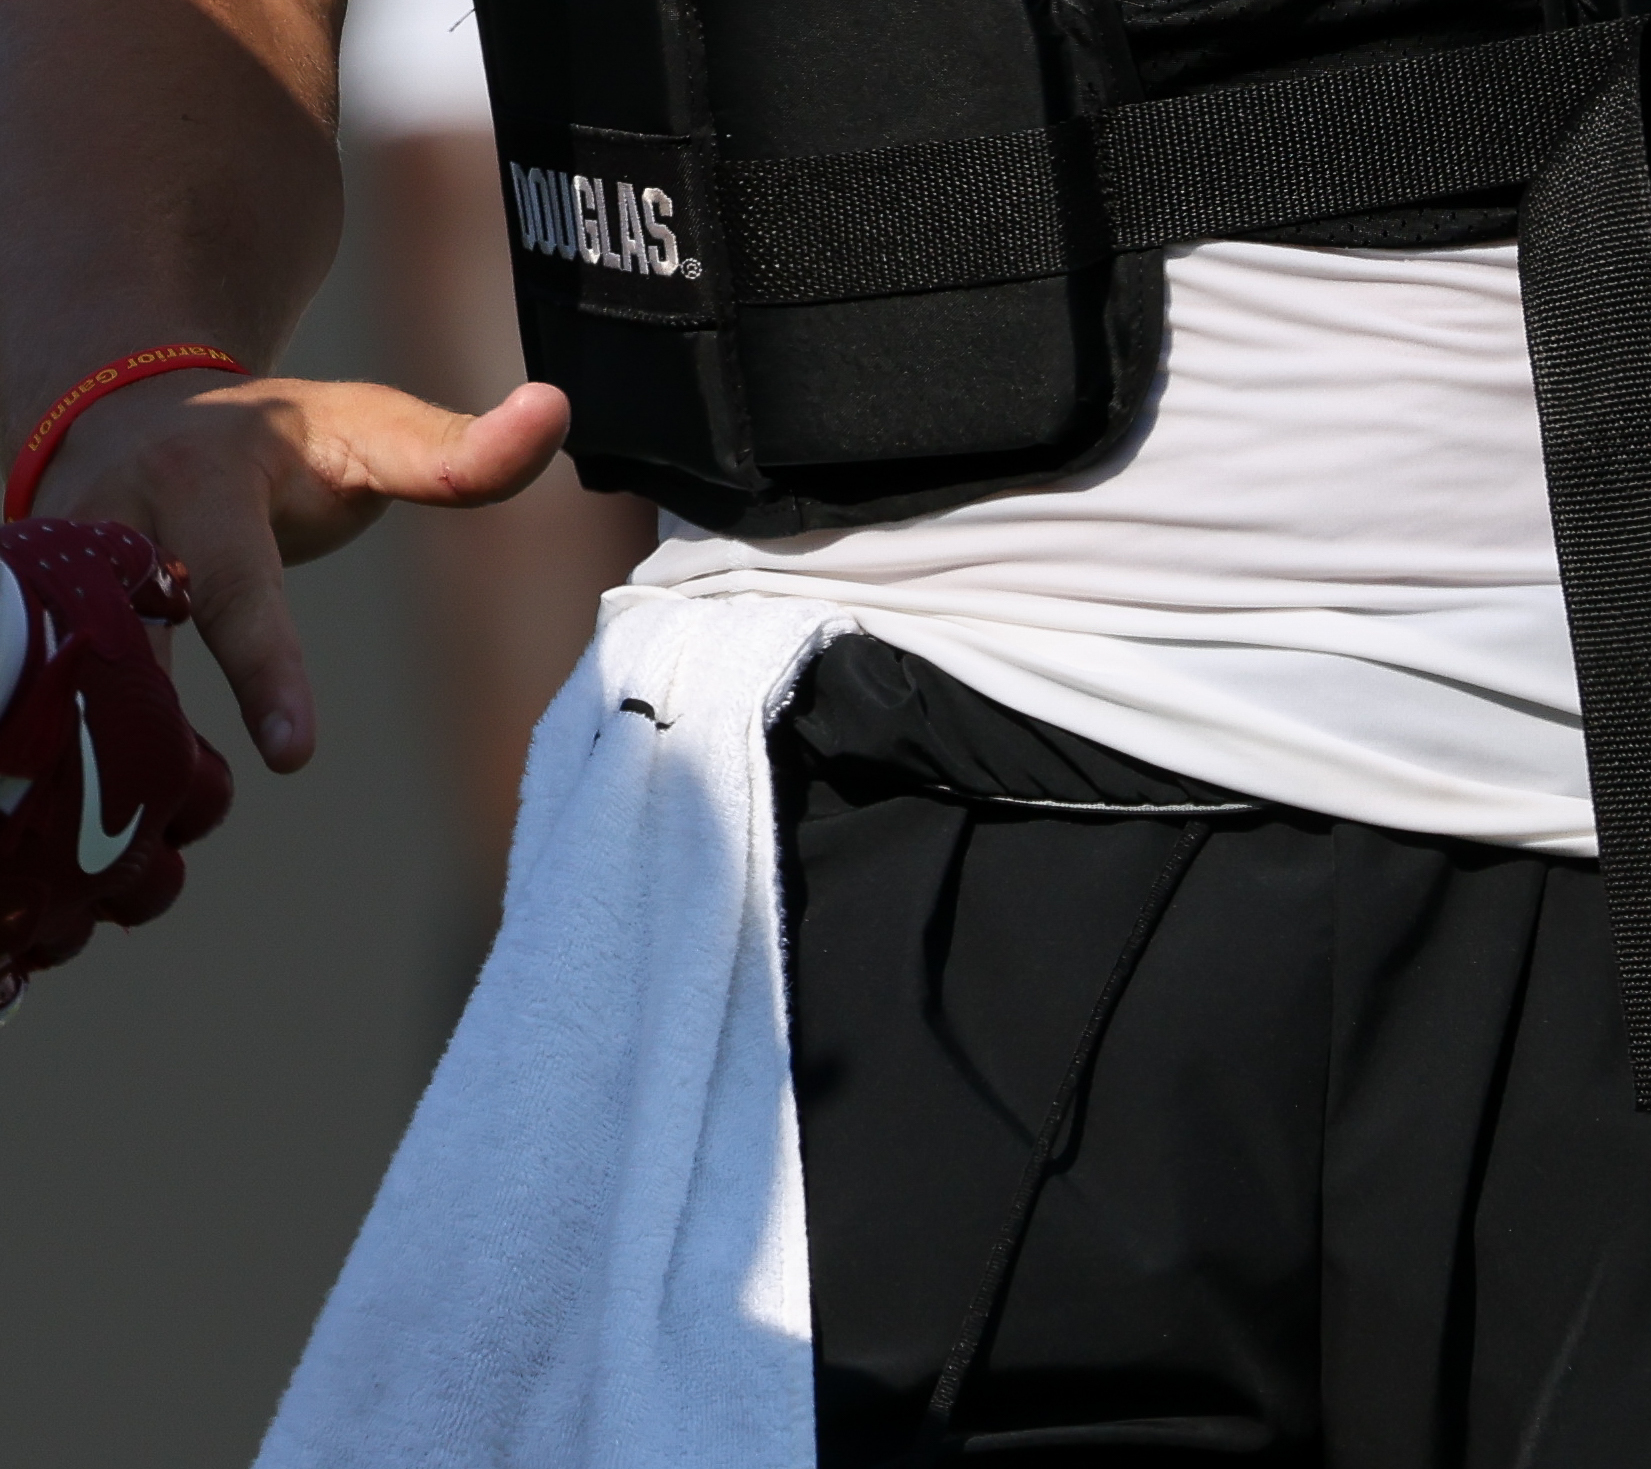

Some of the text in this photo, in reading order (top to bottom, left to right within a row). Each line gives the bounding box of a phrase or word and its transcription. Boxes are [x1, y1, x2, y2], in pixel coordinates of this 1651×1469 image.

[510, 161, 680, 277] DOUGLAS
[27, 345, 234, 452] Warrior Gannon
